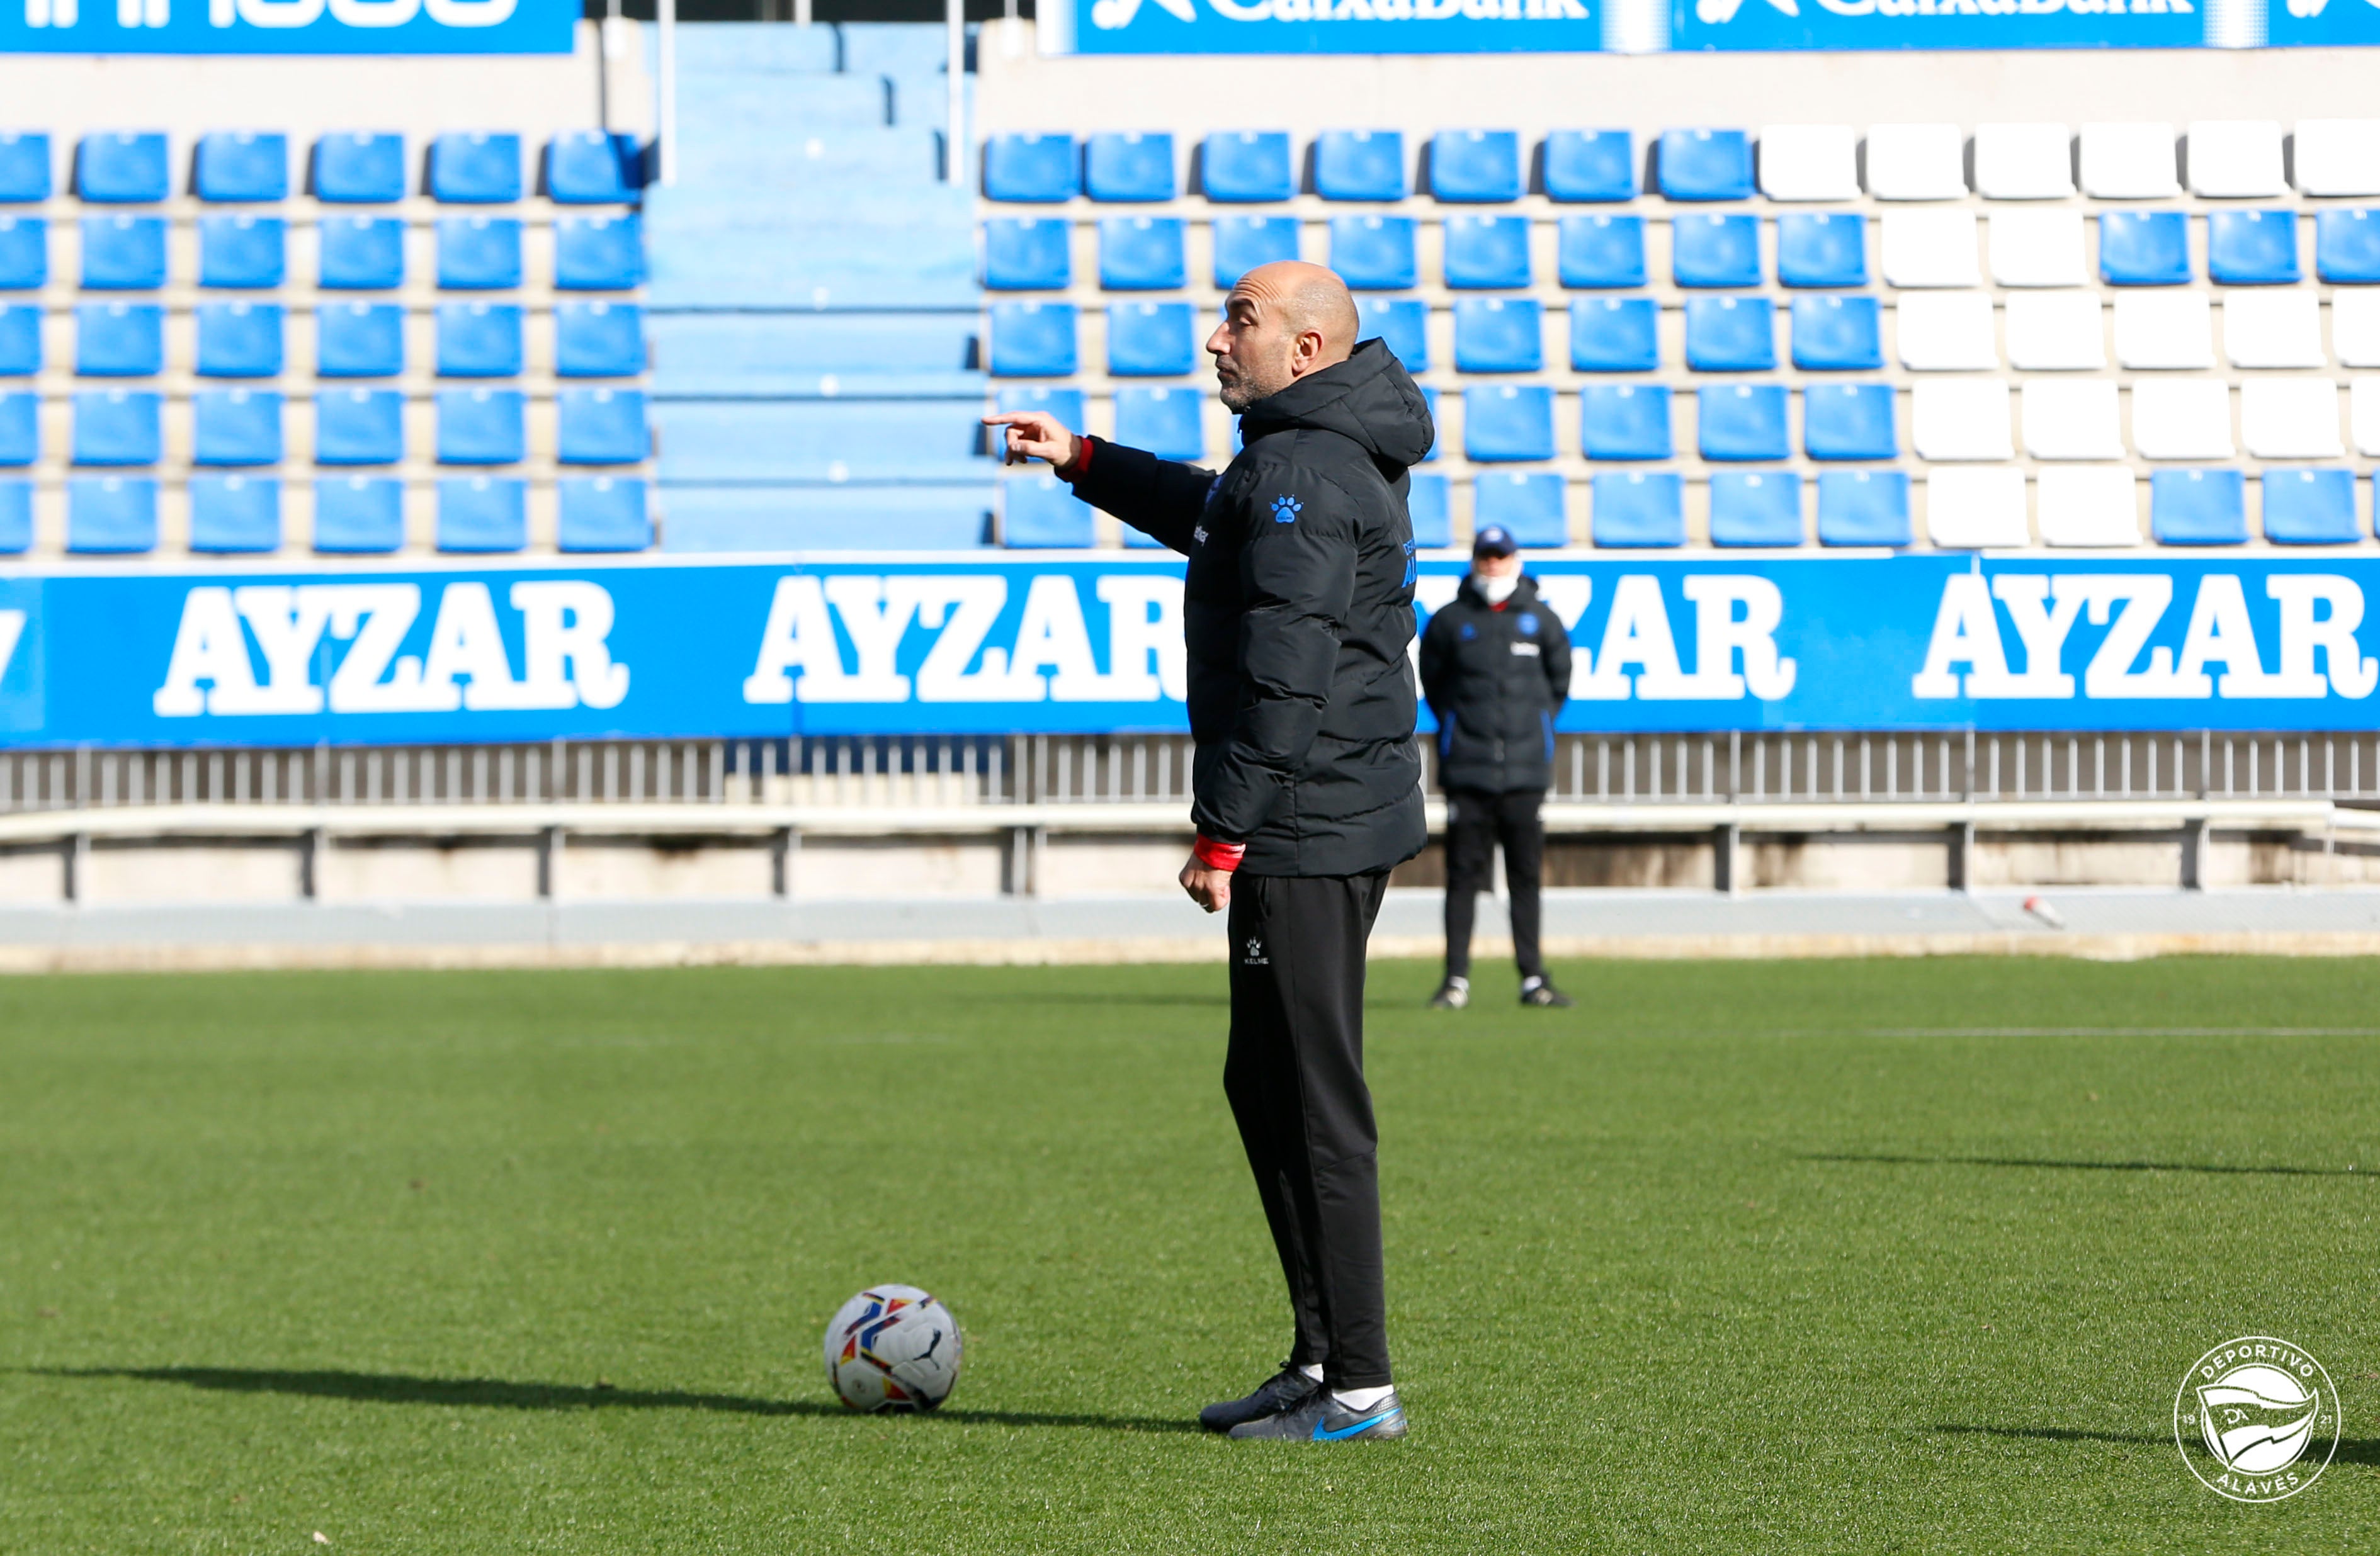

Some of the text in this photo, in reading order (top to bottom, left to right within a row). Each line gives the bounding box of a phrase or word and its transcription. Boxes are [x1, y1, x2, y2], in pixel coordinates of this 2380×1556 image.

[154, 580, 630, 717] AYZAR
[744, 574, 1187, 703] AYZAR
[1912, 573, 2379, 699] AYZAR
